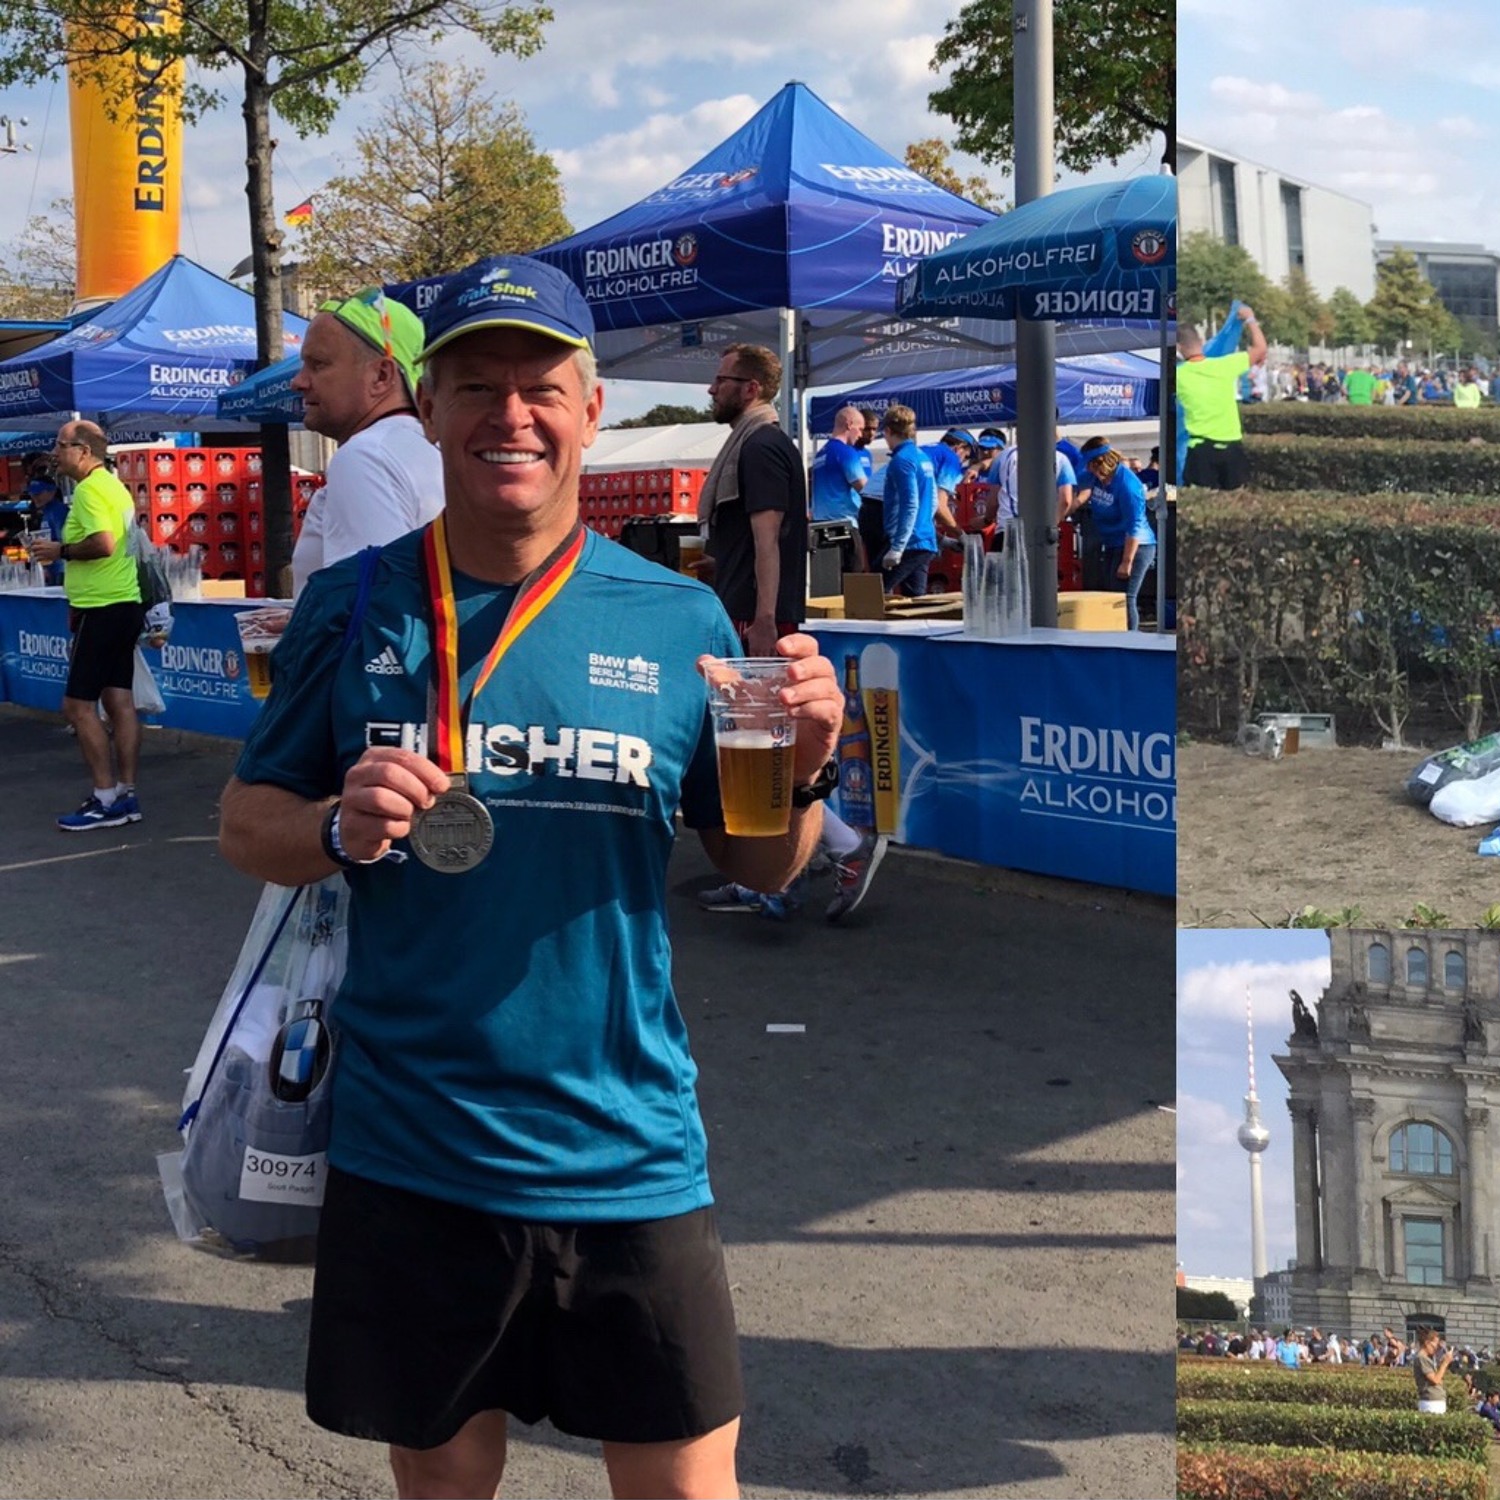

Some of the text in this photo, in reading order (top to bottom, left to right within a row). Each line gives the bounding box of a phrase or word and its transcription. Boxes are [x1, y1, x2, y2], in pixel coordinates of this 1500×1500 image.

[585, 239, 676, 278] ERDINGER
[935, 244, 1097, 285] ALKOHOLFREI
[585, 268, 698, 299] ALKOHOLFREI
[151, 364, 231, 386] ERDINGER
[162, 642, 225, 678] ERDINGER
[365, 662, 403, 675] adidas
[589, 652, 626, 670] BMW
[589, 667, 627, 680] BERLIN
[588, 676, 649, 694] MARATHON
[647, 661, 660, 695] 2018
[1020, 716, 1176, 780] ERDING
[246, 1154, 316, 1178] 30974
